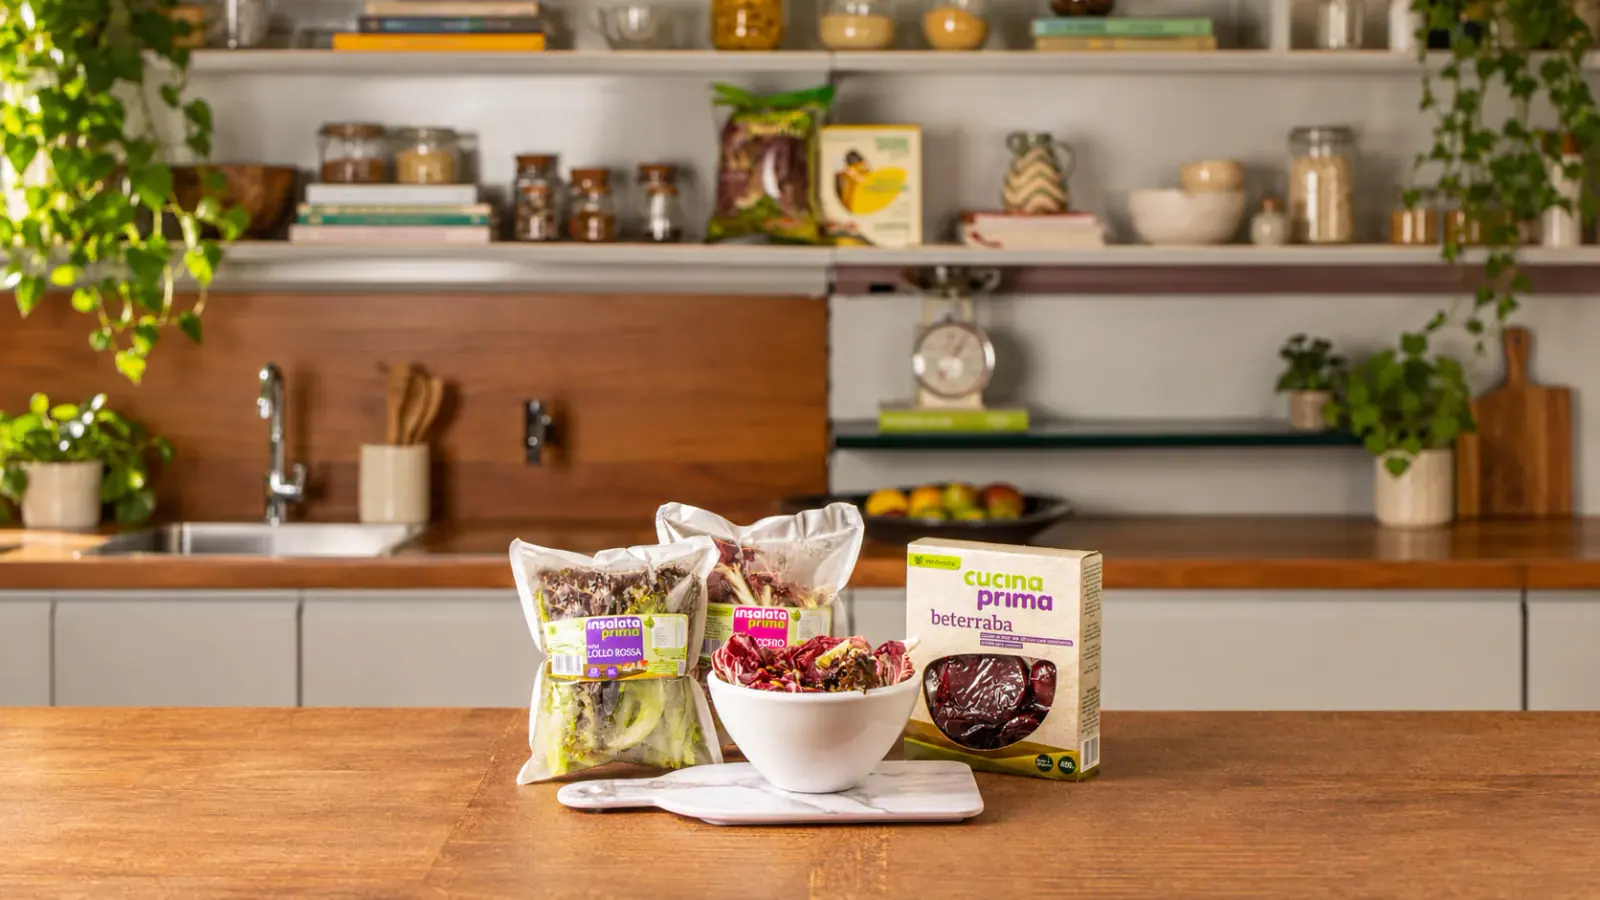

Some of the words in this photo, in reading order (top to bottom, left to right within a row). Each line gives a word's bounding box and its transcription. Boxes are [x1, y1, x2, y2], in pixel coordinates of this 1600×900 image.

[963, 569, 1043, 592] cucina
[976, 588, 1053, 611] prima
[735, 608, 787, 620] insalata
[930, 608, 1013, 632] beterraba
[587, 617, 640, 630] insalata
[747, 618, 785, 630] prima
[601, 627, 640, 641] prima
[754, 638, 785, 648] CCHIO
[587, 648, 614, 658] LOLLO
[615, 648, 642, 657] ROSSA
